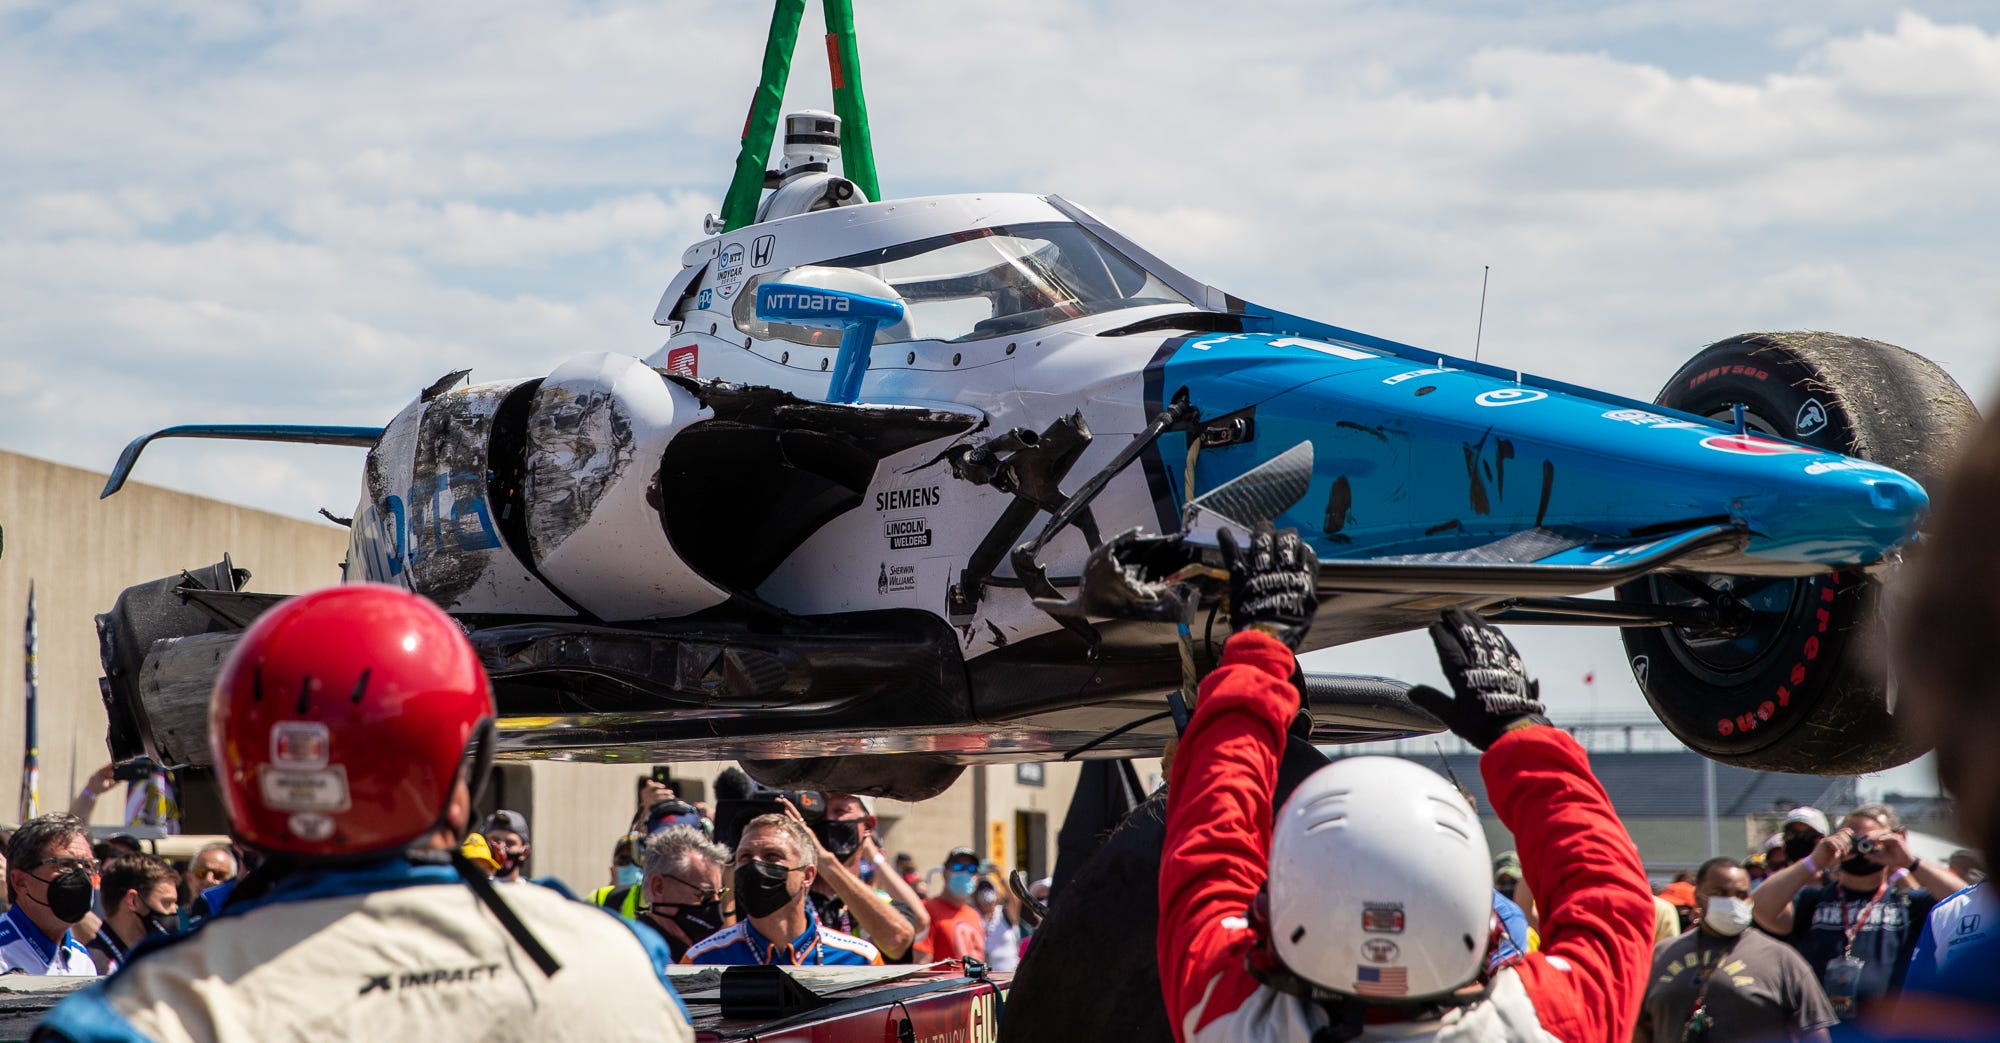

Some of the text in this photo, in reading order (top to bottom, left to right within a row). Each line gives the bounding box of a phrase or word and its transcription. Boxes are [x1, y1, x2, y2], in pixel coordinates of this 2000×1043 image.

[717, 267, 742, 280] INDYCAR
[766, 293, 796, 309] NTT
[876, 486, 940, 511] SIEMENS
[886, 520, 924, 536] LINCOLN
[894, 535, 927, 548] WELDERS
[890, 564, 915, 576] SHERWIN
[400, 963, 500, 988] IMPACT
